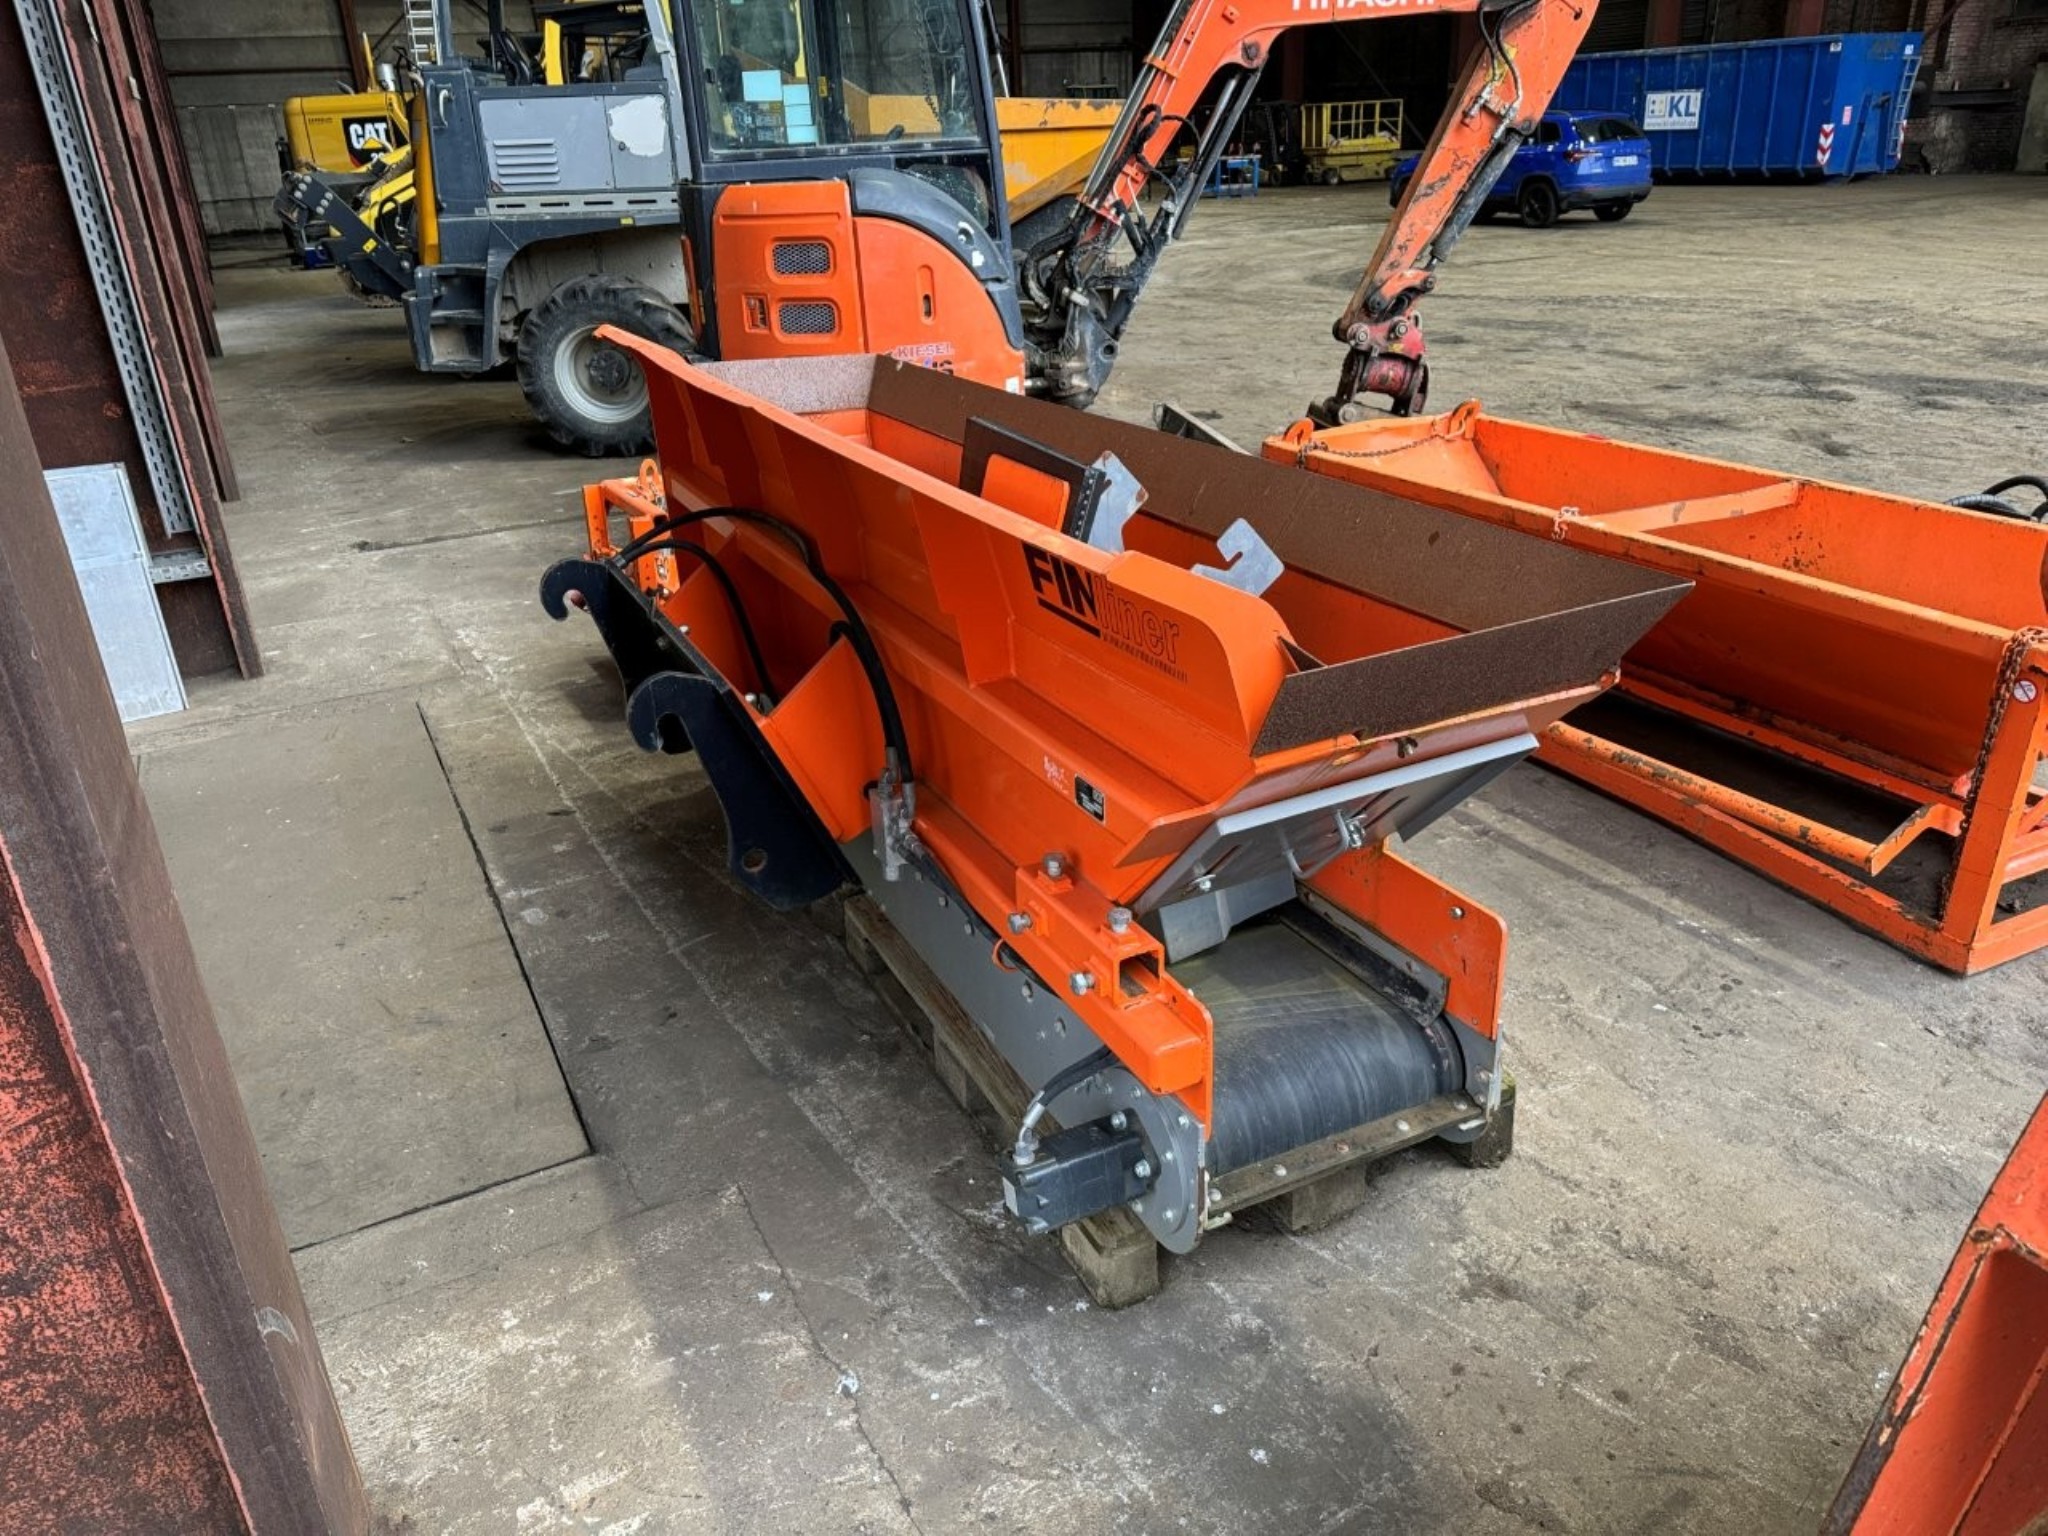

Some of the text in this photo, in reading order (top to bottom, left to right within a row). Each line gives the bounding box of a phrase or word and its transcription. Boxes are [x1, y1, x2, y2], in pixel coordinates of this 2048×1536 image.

[1668, 95, 1696, 118] KL
[349, 122, 387, 149] CAT
[897, 343, 952, 357] KIESEL
